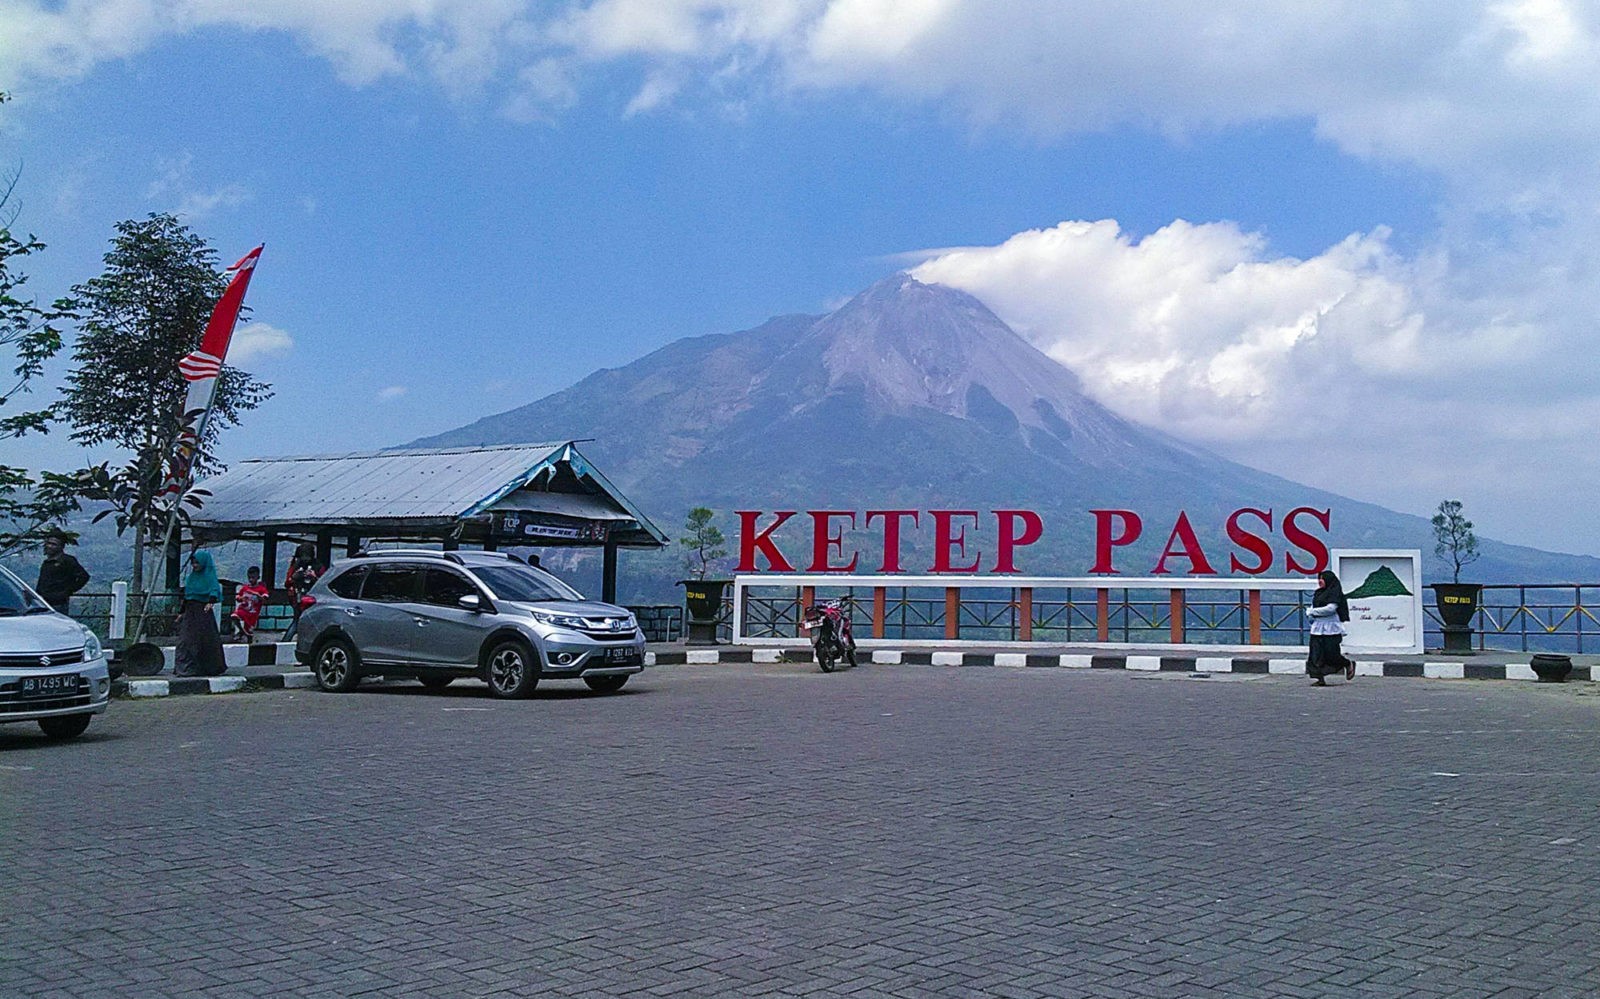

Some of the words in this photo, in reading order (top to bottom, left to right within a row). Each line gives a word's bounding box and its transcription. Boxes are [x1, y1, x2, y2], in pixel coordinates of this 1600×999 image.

[732, 510, 1043, 573] KETEP
[1087, 507, 1331, 575] PASS
[24, 679, 35, 690] AB
